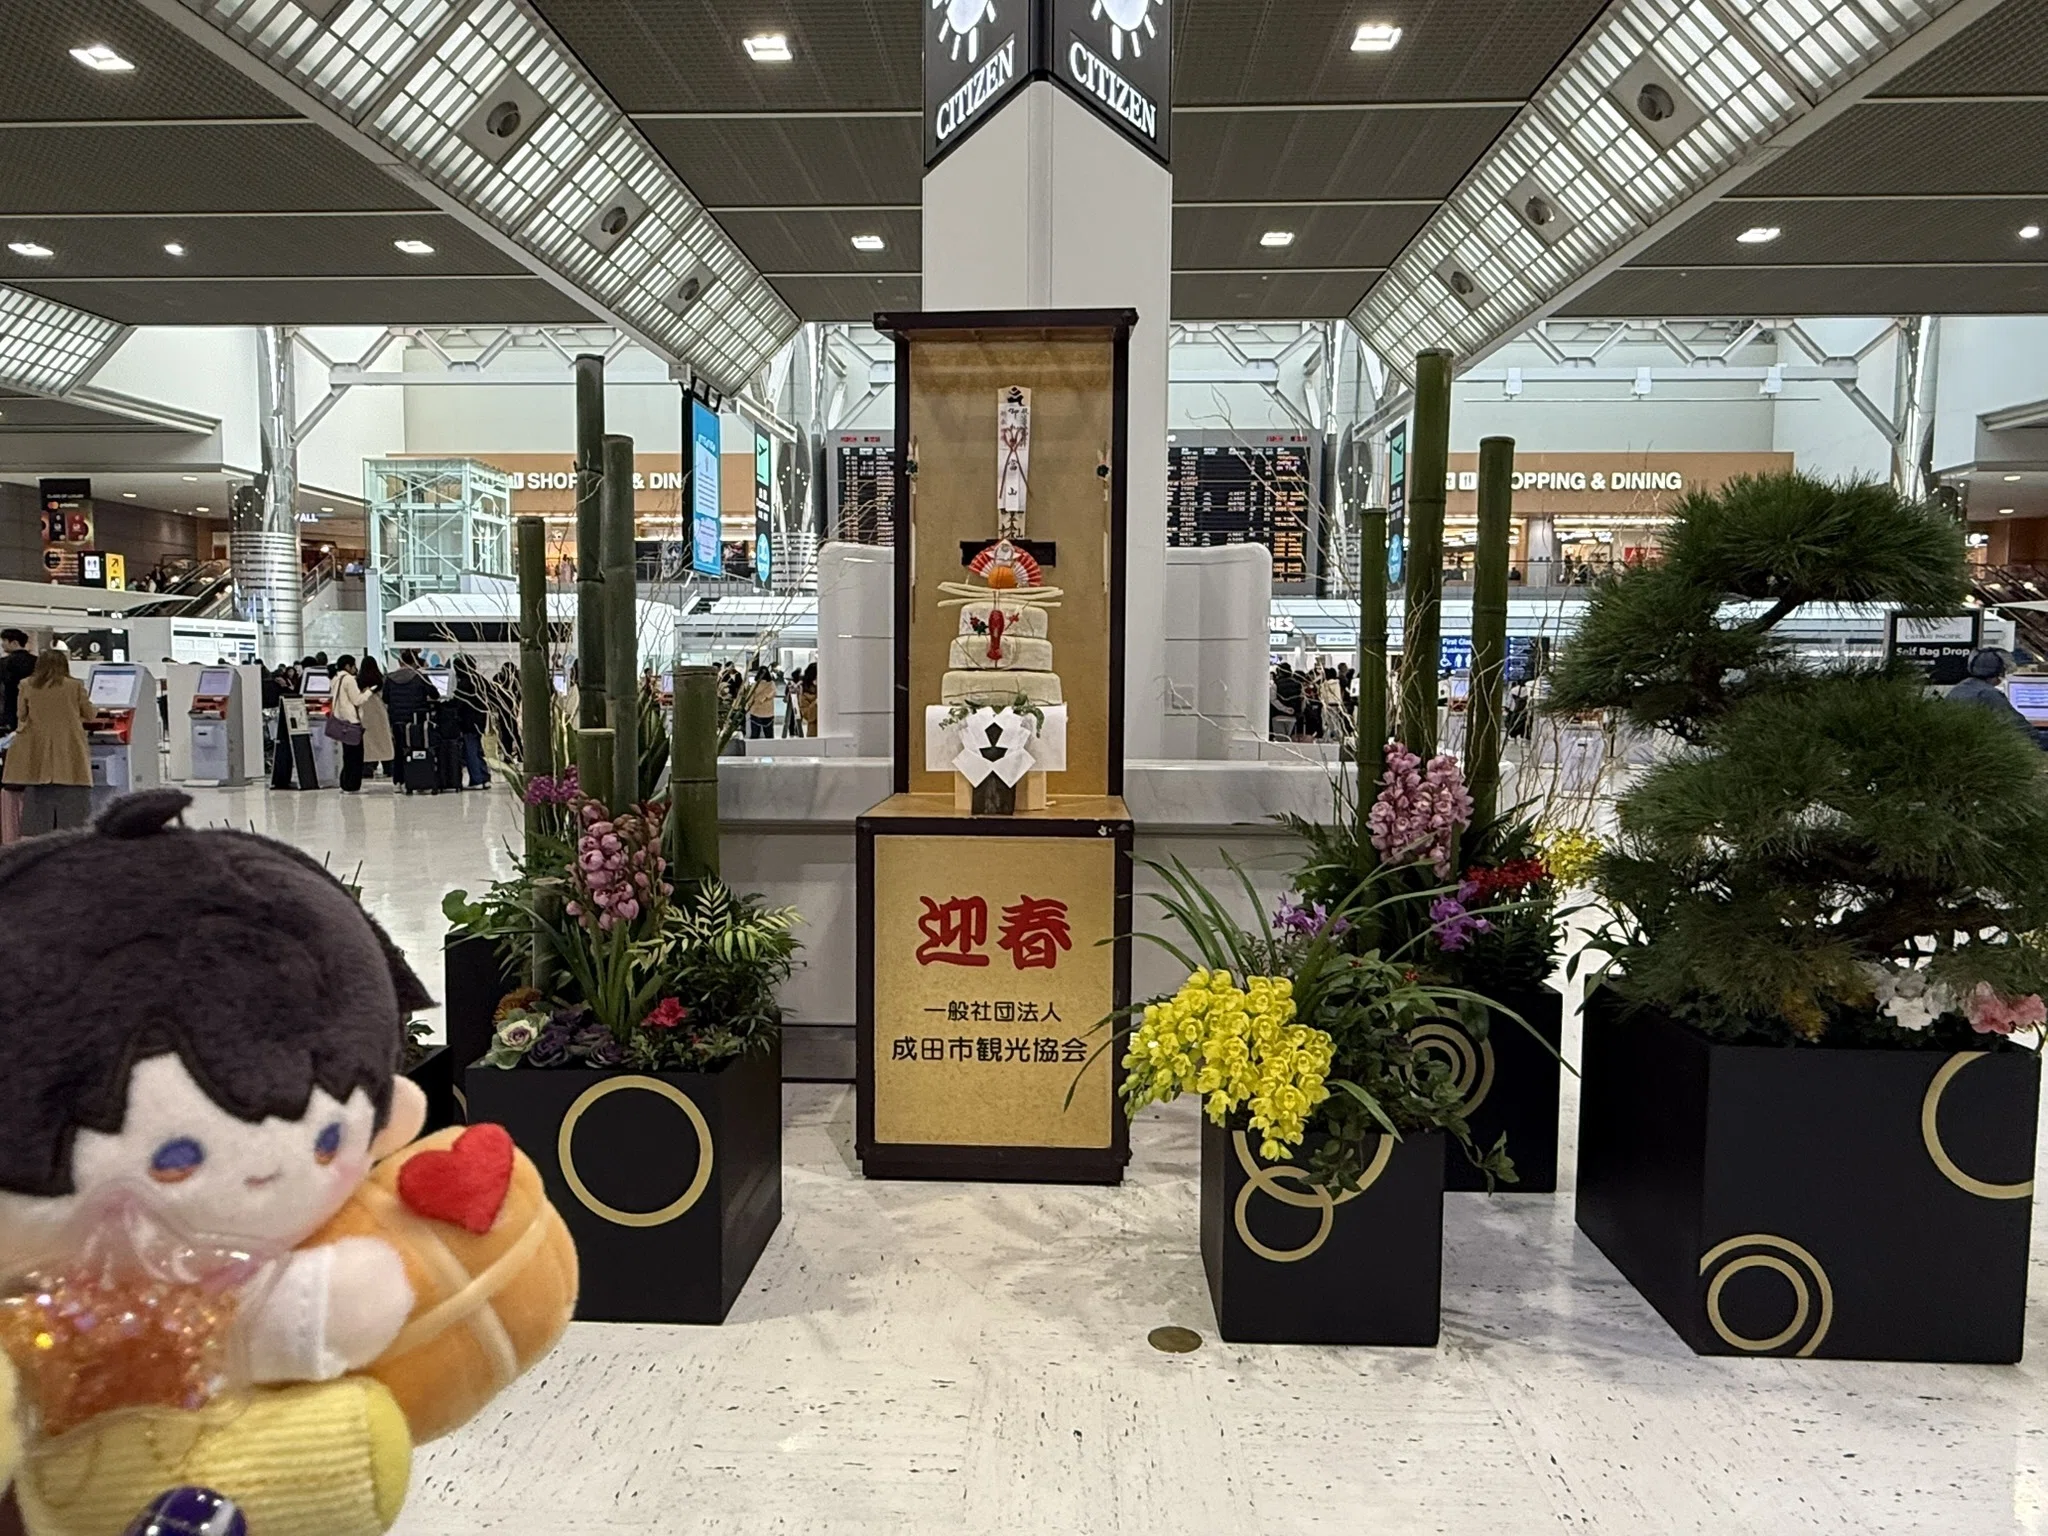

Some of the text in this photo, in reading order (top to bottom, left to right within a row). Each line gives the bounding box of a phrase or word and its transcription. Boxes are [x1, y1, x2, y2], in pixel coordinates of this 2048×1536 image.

[936, 40, 1015, 140] CITIZEN
[1069, 41, 1157, 140] CITIZEN
[527, 472, 577, 490] SHOP
[650, 472, 682, 490] DIN
[1511, 471, 1682, 490] OPPING & DINING
[1442, 638, 1457, 646] First
[1896, 647, 1971, 658] Self Bag Drop
[915, 894, 1073, 970] 迎春
[923, 1000, 1063, 1023] 一般社団法人
[891, 1037, 1089, 1063] 成田市観光協会
